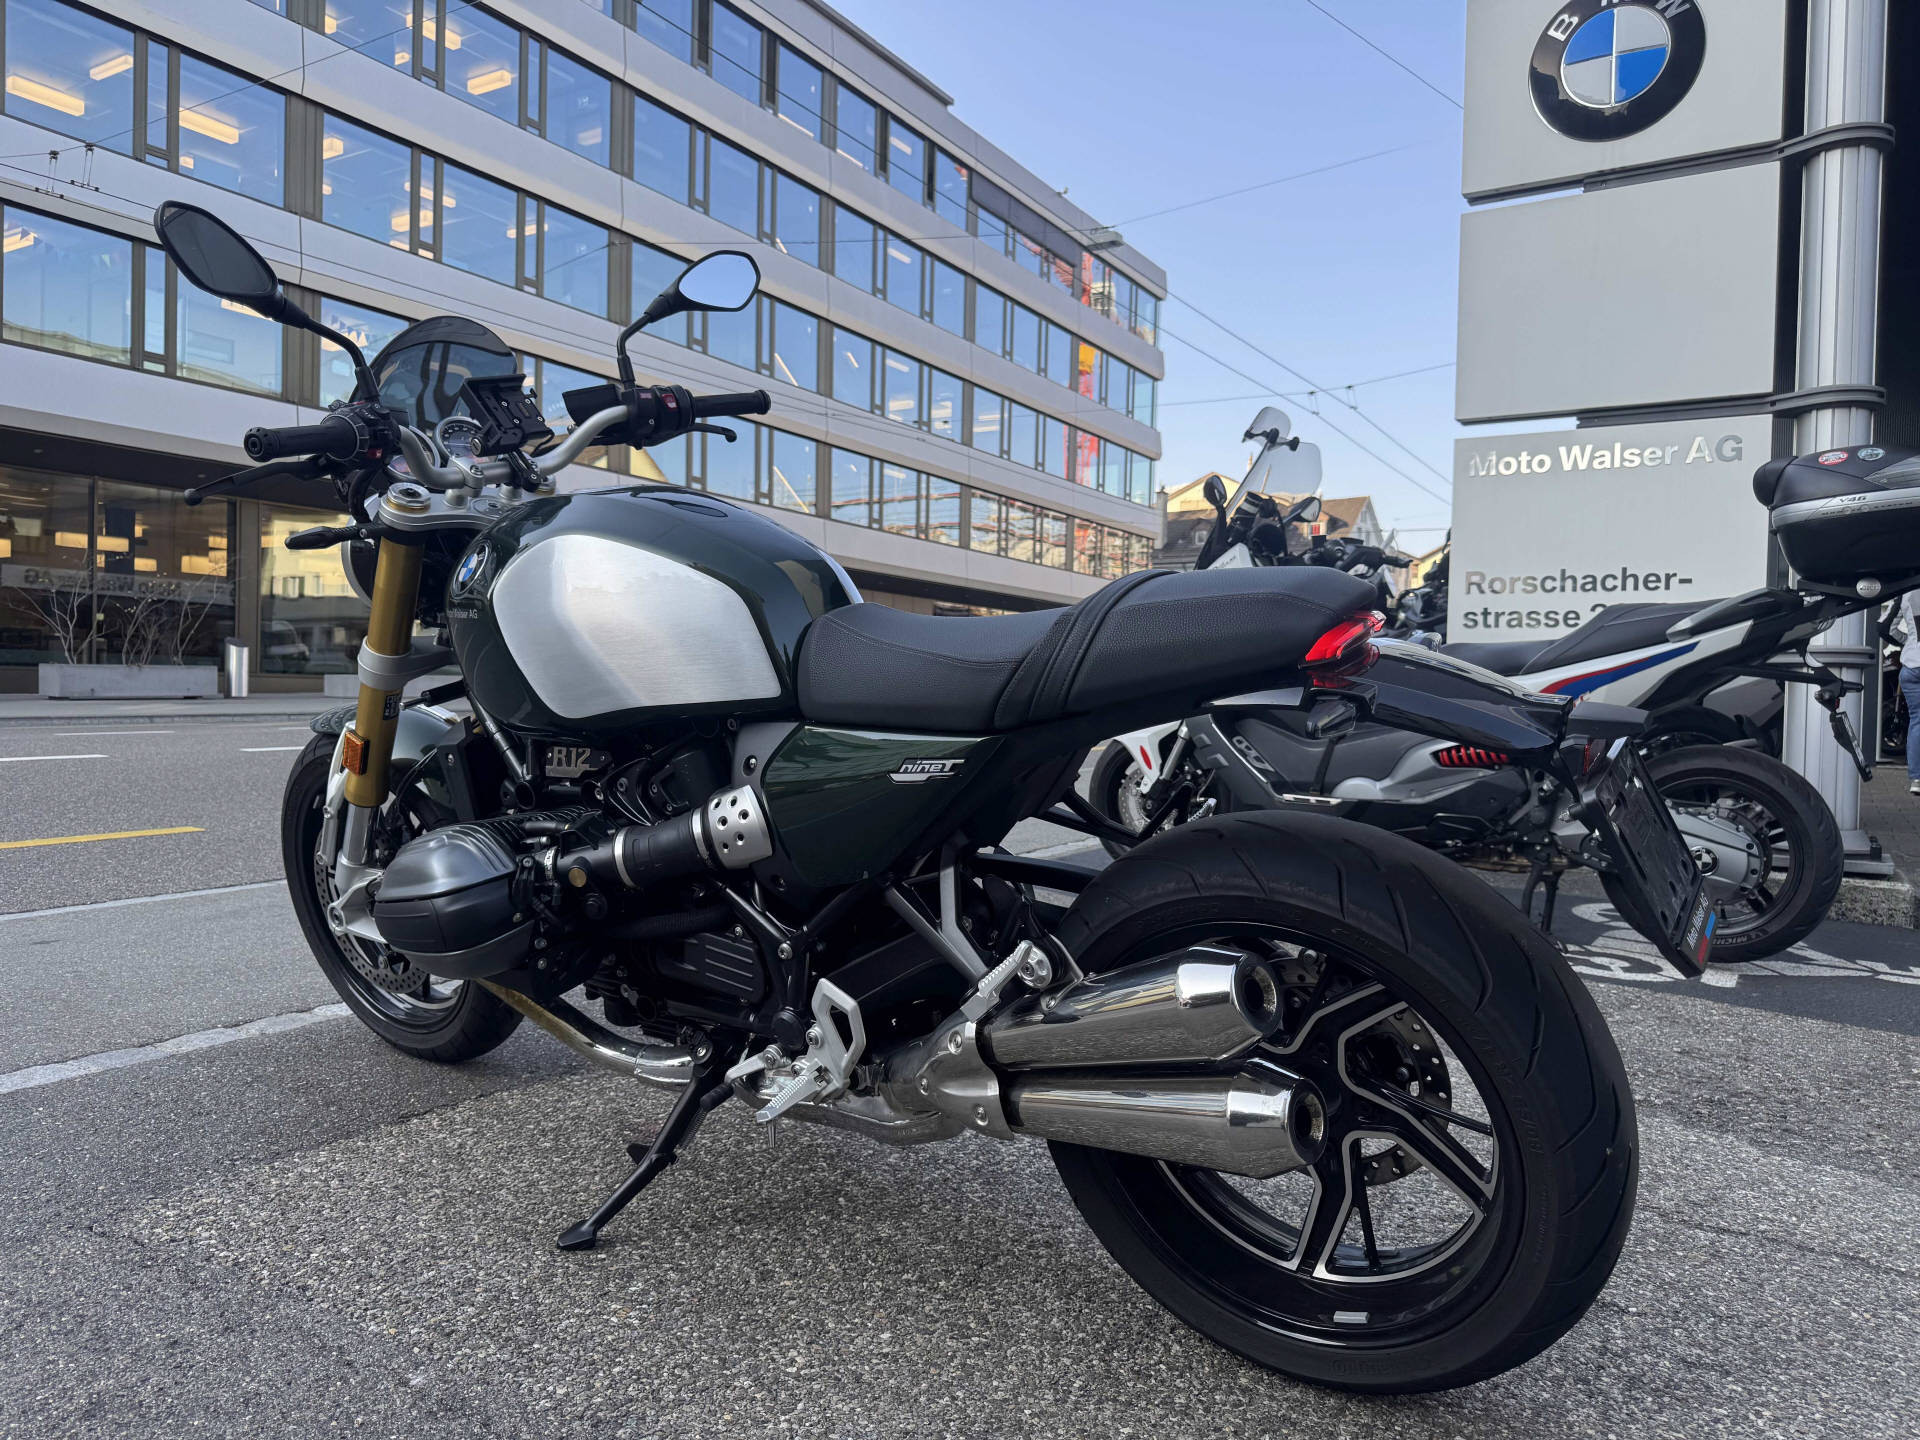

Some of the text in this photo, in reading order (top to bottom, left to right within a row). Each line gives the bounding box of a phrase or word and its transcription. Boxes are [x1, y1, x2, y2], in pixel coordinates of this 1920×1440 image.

[1468, 435, 1743, 477] Moto Walser AG
[1464, 566, 1693, 595] Rorschacher-
[1463, 605, 1581, 629] strasse
[552, 746, 591, 769] R12
[899, 759, 965, 772] nineT
